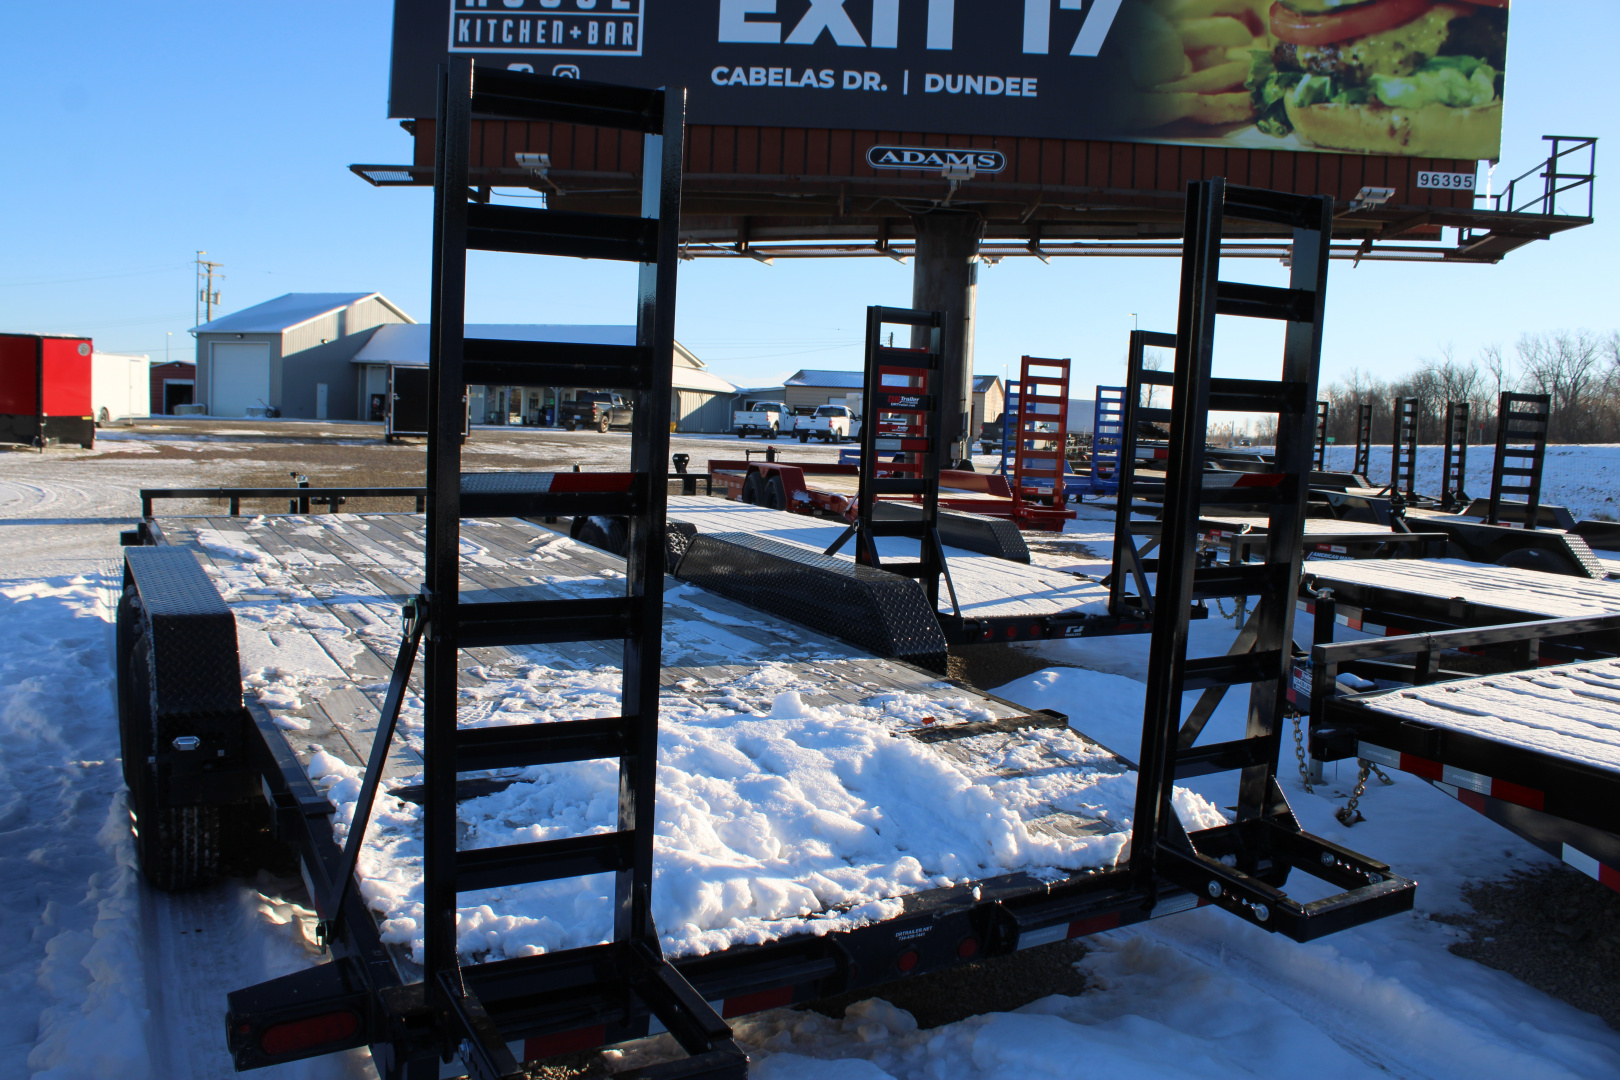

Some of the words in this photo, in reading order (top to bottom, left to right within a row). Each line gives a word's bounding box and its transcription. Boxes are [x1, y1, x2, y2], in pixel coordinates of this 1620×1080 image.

[710, 66, 835, 89] CABELAS
[843, 70, 888, 92] DR.
[924, 73, 1038, 97] DUNDEE
[878, 150, 996, 168] ADAMS
[1420, 173, 1473, 188] 96395
